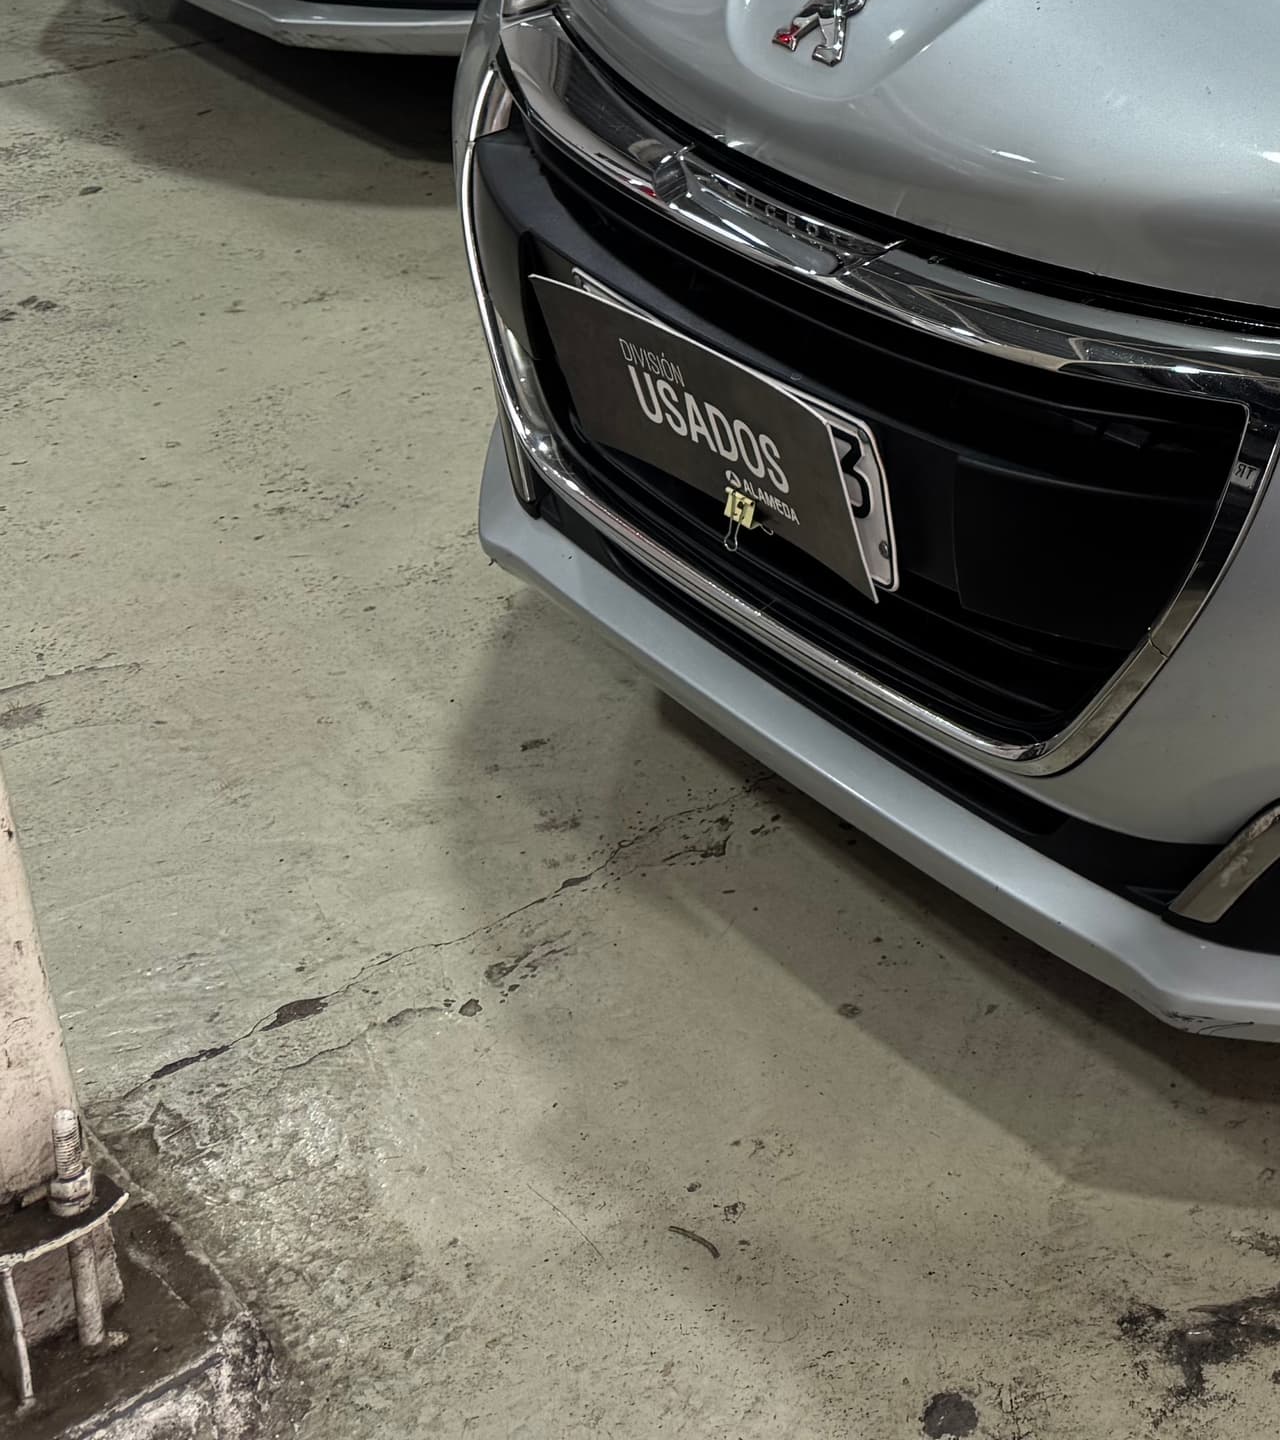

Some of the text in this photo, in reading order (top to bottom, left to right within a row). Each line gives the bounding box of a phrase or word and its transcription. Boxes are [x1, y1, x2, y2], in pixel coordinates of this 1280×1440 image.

[618, 337, 686, 388] DIVISIÓN
[627, 364, 790, 494] USADOS
[743, 478, 801, 526] ALAMEDA
